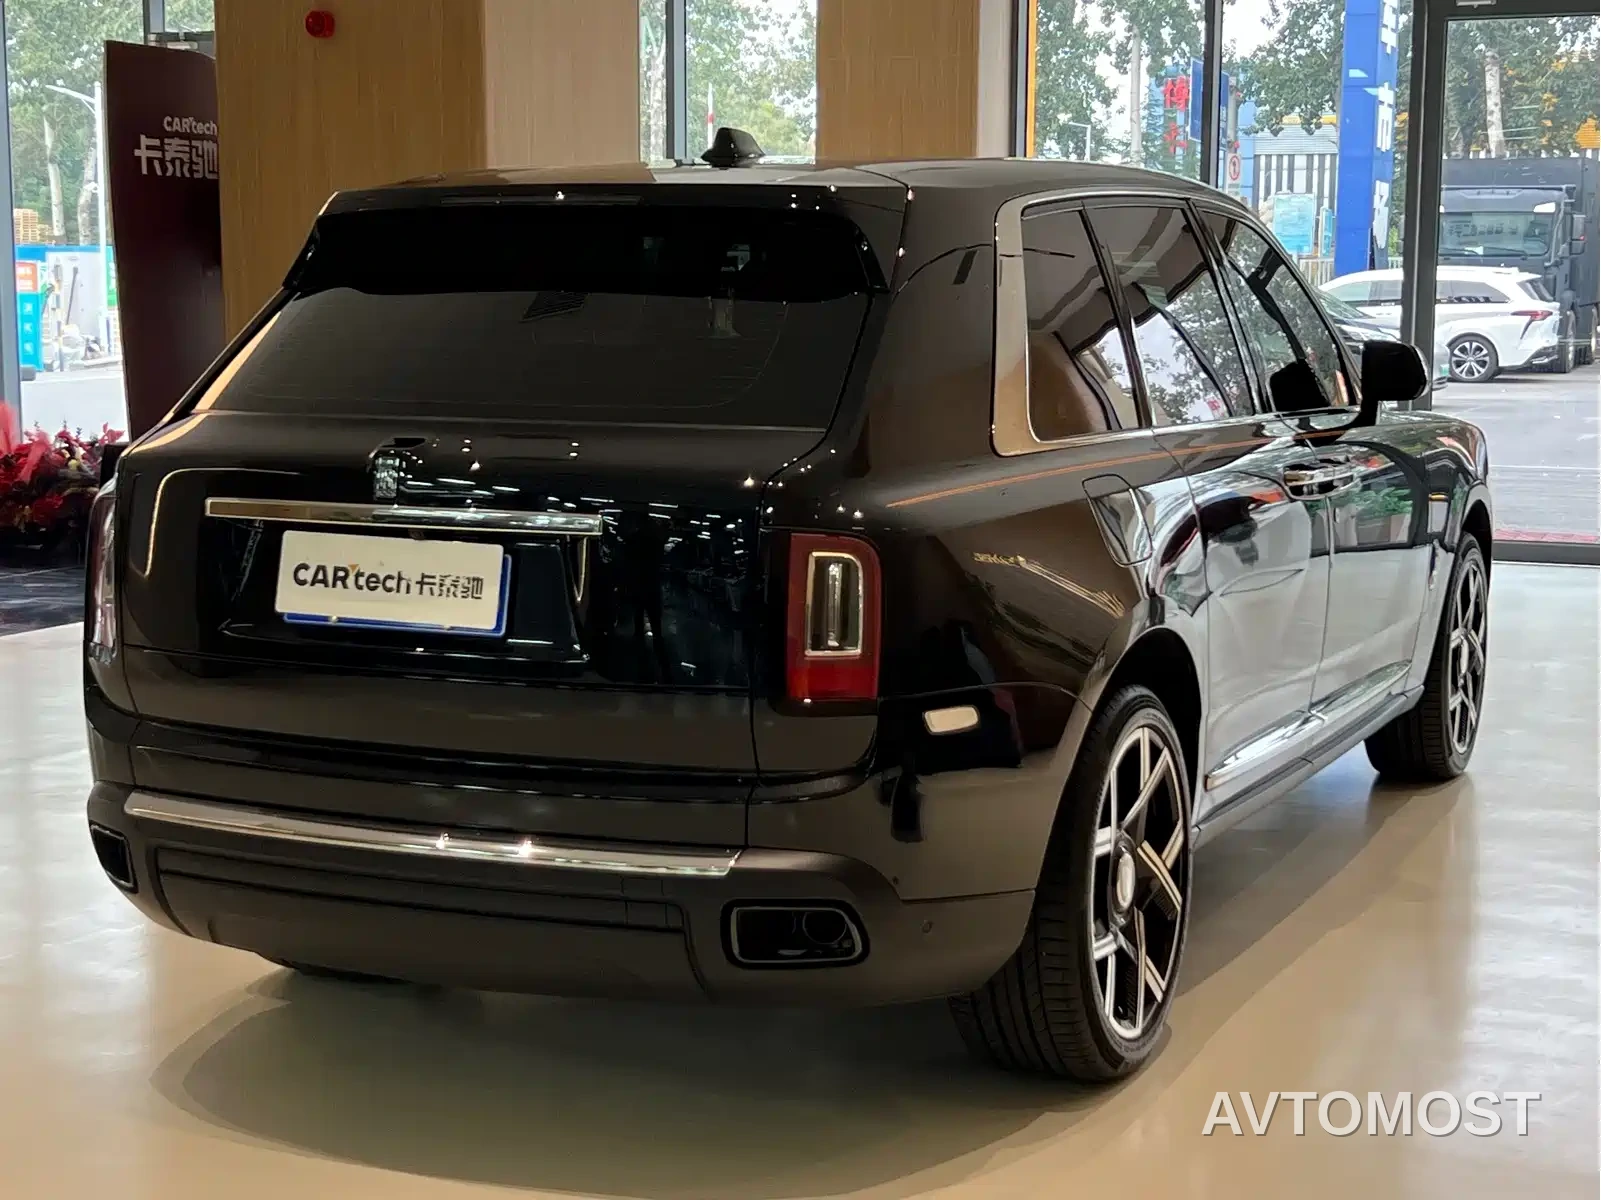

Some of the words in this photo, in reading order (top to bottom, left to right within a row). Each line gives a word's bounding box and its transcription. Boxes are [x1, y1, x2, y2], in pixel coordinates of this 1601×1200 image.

[163, 116, 218, 136] CARtech
[134, 133, 220, 179] 卡泰驰
[293, 562, 412, 595] CARtech
[415, 572, 484, 600] 卡泰驰
